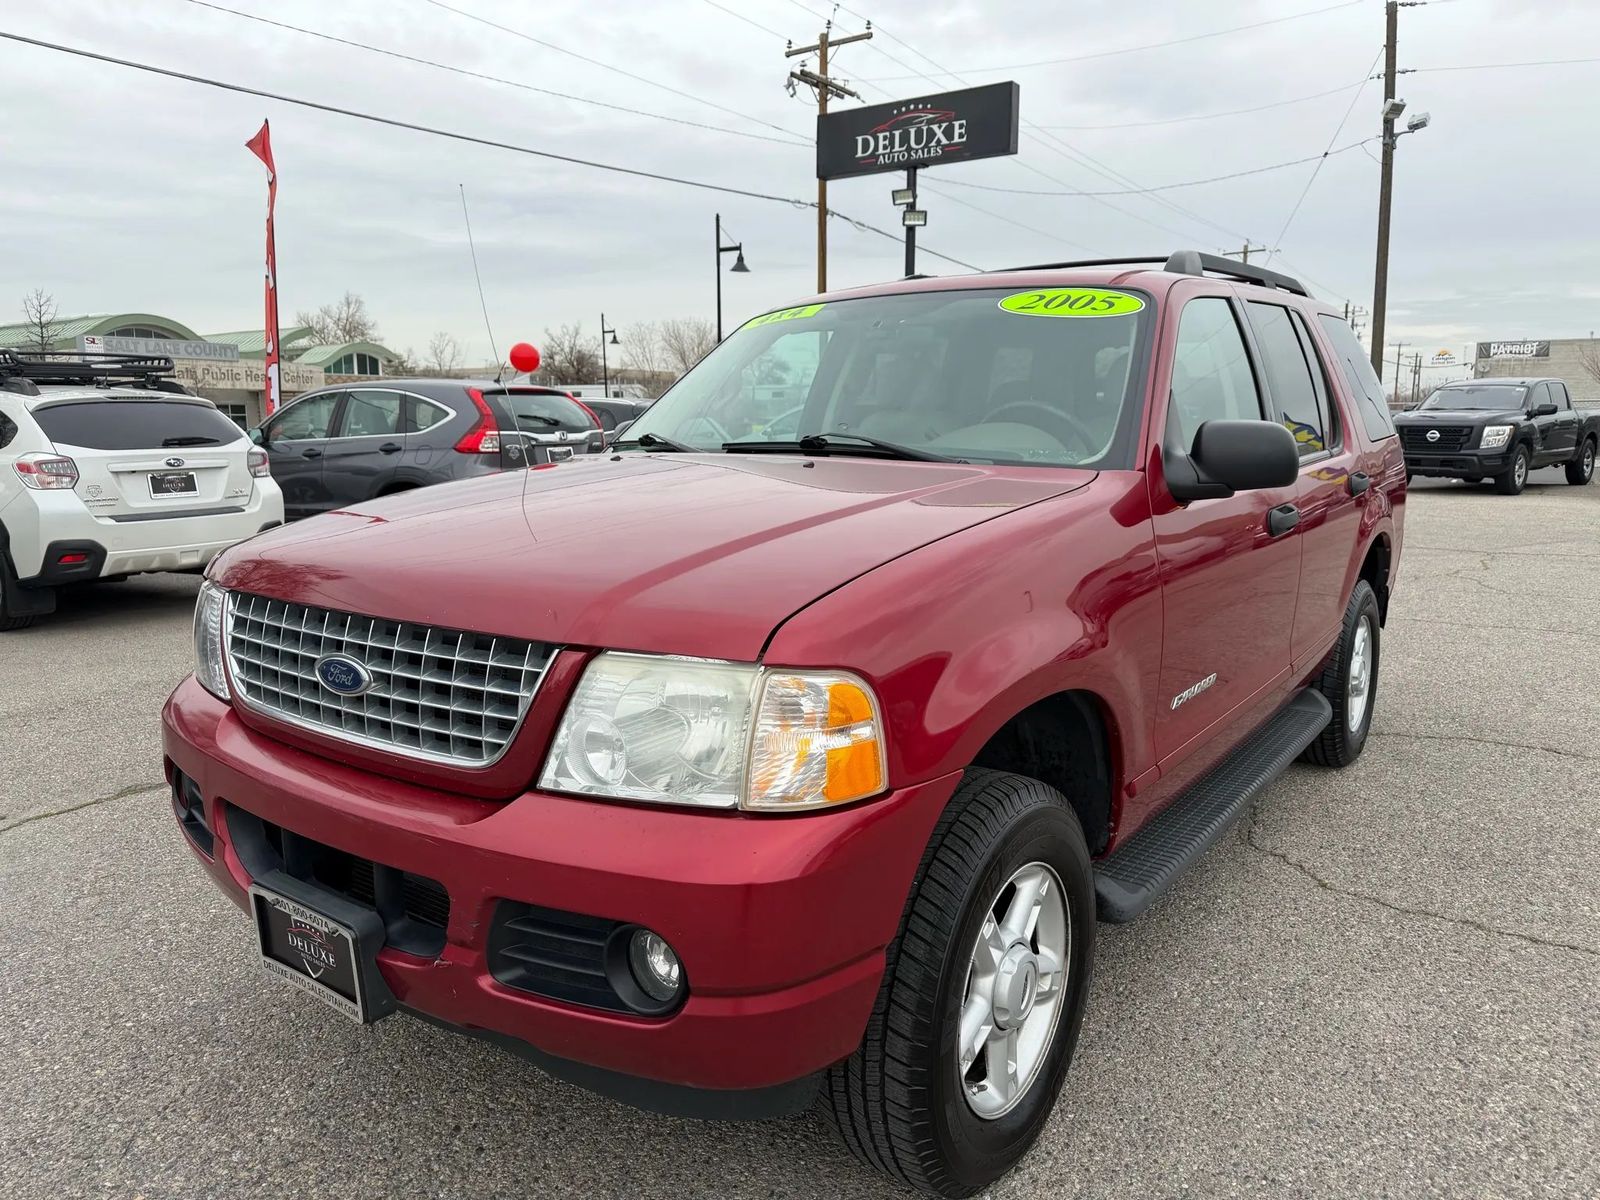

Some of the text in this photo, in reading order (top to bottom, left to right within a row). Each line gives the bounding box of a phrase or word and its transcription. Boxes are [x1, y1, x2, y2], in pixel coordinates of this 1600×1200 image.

[855, 119, 967, 158] DELUXE
[877, 146, 943, 165] AUTO SALES
[1015, 293, 1121, 312] 2005
[104, 338, 141, 354] SALT
[144, 340, 181, 356] LAKE
[184, 341, 240, 360] COUNTY
[1489, 341, 1539, 356] PATRIOT
[202, 367, 241, 382] Public
[283, 371, 315, 386] Center
[327, 663, 354, 686] Ford
[287, 932, 337, 968] DELUXE
[262, 959, 289, 979] DELUXE
[289, 973, 307, 988] AUTO
[307, 981, 326, 999] SALES
